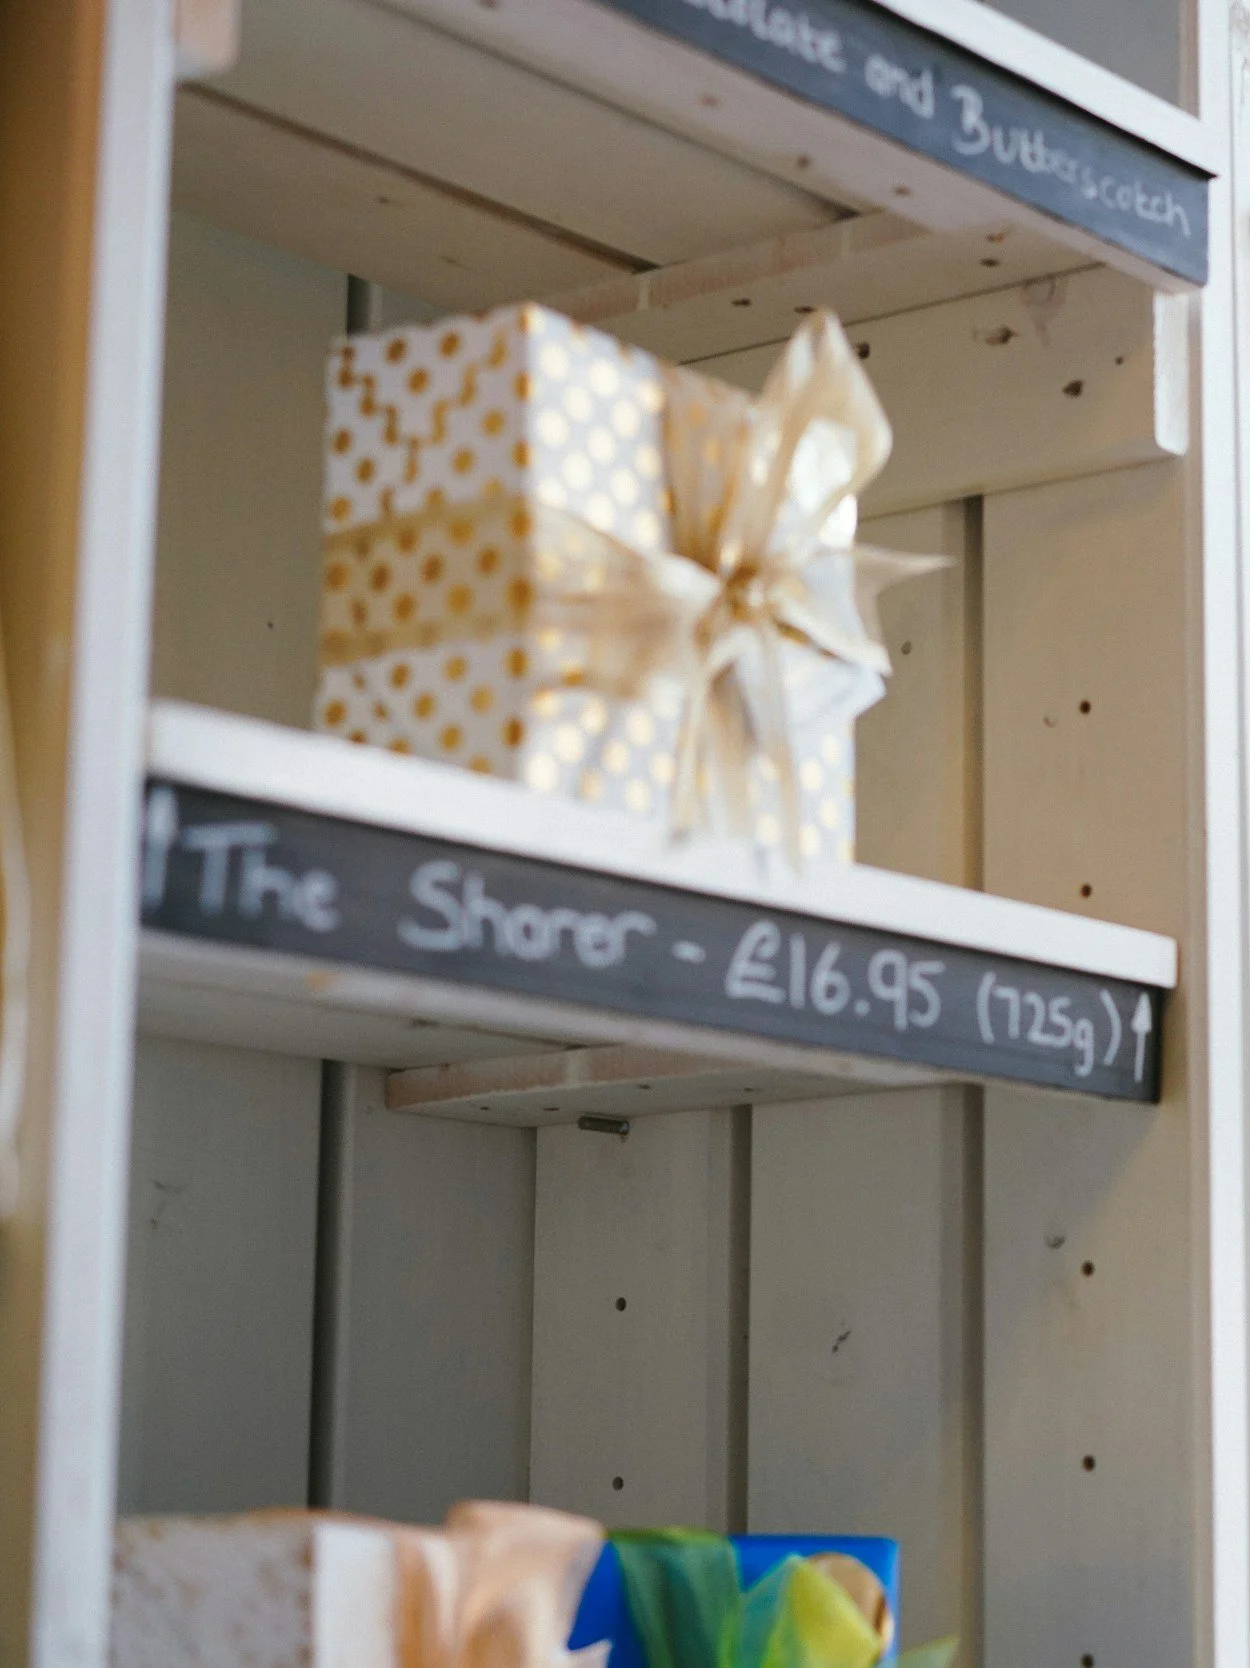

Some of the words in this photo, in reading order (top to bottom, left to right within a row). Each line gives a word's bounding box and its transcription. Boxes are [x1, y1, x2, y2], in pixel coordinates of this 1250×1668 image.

[864, 50, 934, 119] and
[181, 819, 341, 934] The
[397, 859, 659, 969] Sharer
[726, 919, 947, 1033] £16.95
[975, 971, 1122, 1078] (725g)
